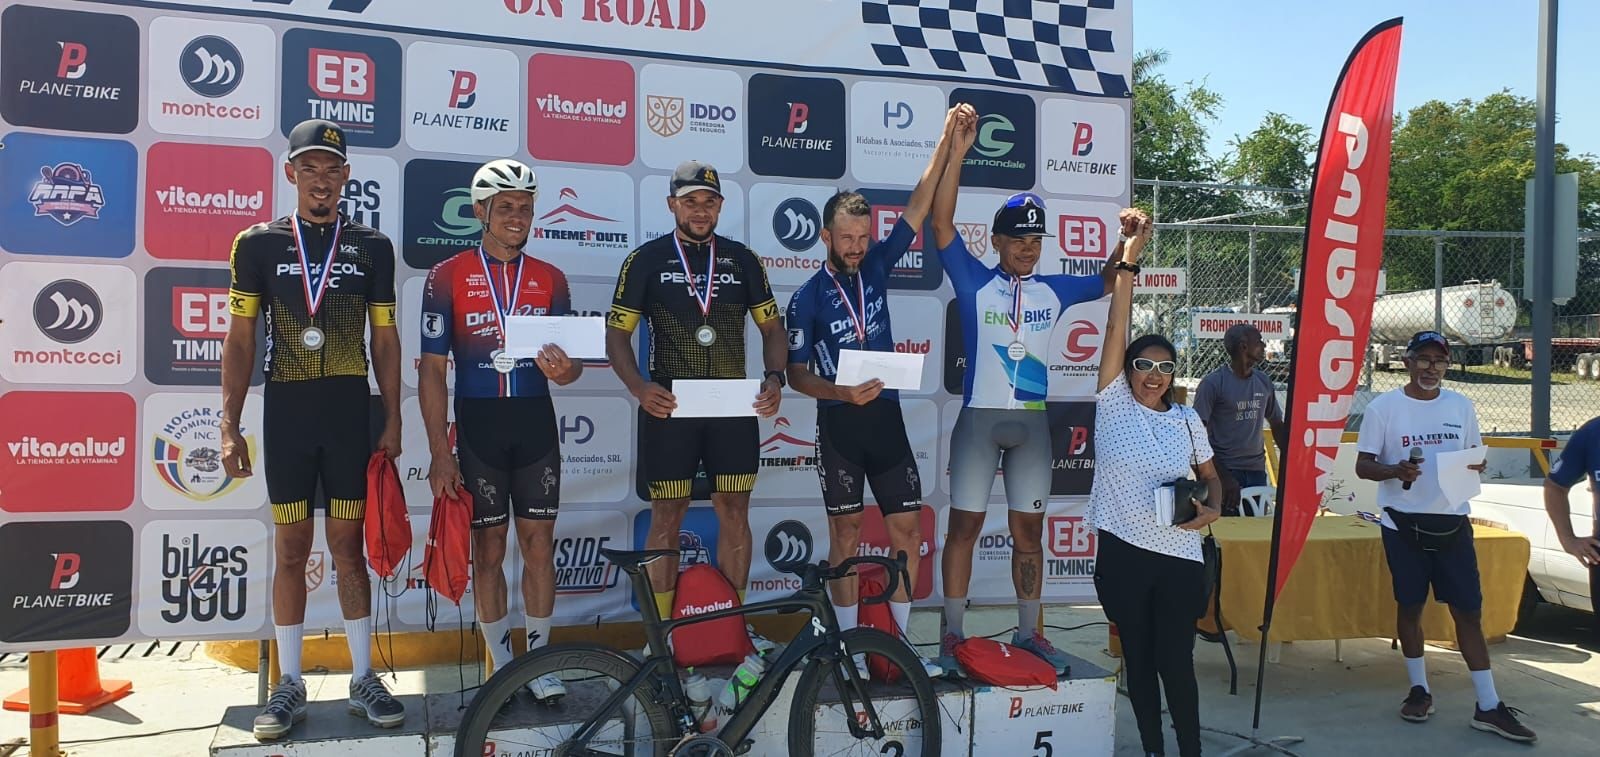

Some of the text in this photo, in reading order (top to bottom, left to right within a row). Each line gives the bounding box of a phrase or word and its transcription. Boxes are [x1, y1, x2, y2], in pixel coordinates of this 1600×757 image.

[317, 54, 368, 96] EB
[20, 80, 121, 100] PLANETBIKE
[162, 101, 261, 121] montecci
[308, 98, 374, 123] TIMING
[536, 94, 627, 119] vitasalud
[690, 103, 736, 122] IDDO
[413, 111, 510, 132] PLANETBIKE
[762, 136, 832, 151] PLANETBIKE
[961, 157, 1026, 170] cannondale
[1046, 159, 1117, 176] PLANETBIKE
[156, 186, 263, 210] vitasalud
[222, 209, 256, 217] VITAMINAS
[1065, 219, 1101, 253] EB
[760, 256, 821, 270] montec
[1145, 274, 1177, 288] MOTOR
[1304, 112, 1369, 495] vitasalud
[14, 348, 121, 365] montecci
[1050, 364, 1099, 372] cannonda
[163, 407, 211, 434] HOGAR
[194, 432, 216, 441] INC.
[7, 436, 126, 457] vitasalud
[566, 454, 606, 465] Asociados,
[607, 455, 622, 463] SRL
[1051, 459, 1095, 470] LANETBI
[584, 467, 613, 475] Seguros
[1054, 521, 1091, 553] EB
[162, 533, 248, 579] bikes
[1047, 559, 1095, 576] TIMING
[193, 568, 218, 594] 4
[751, 578, 800, 591] monte
[13, 593, 114, 608] PLANETBIKE
[161, 577, 247, 624] you
[681, 600, 733, 616] vitasalud
[1024, 702, 1084, 717] PLANETBIKE
[1033, 731, 1053, 757] 5
